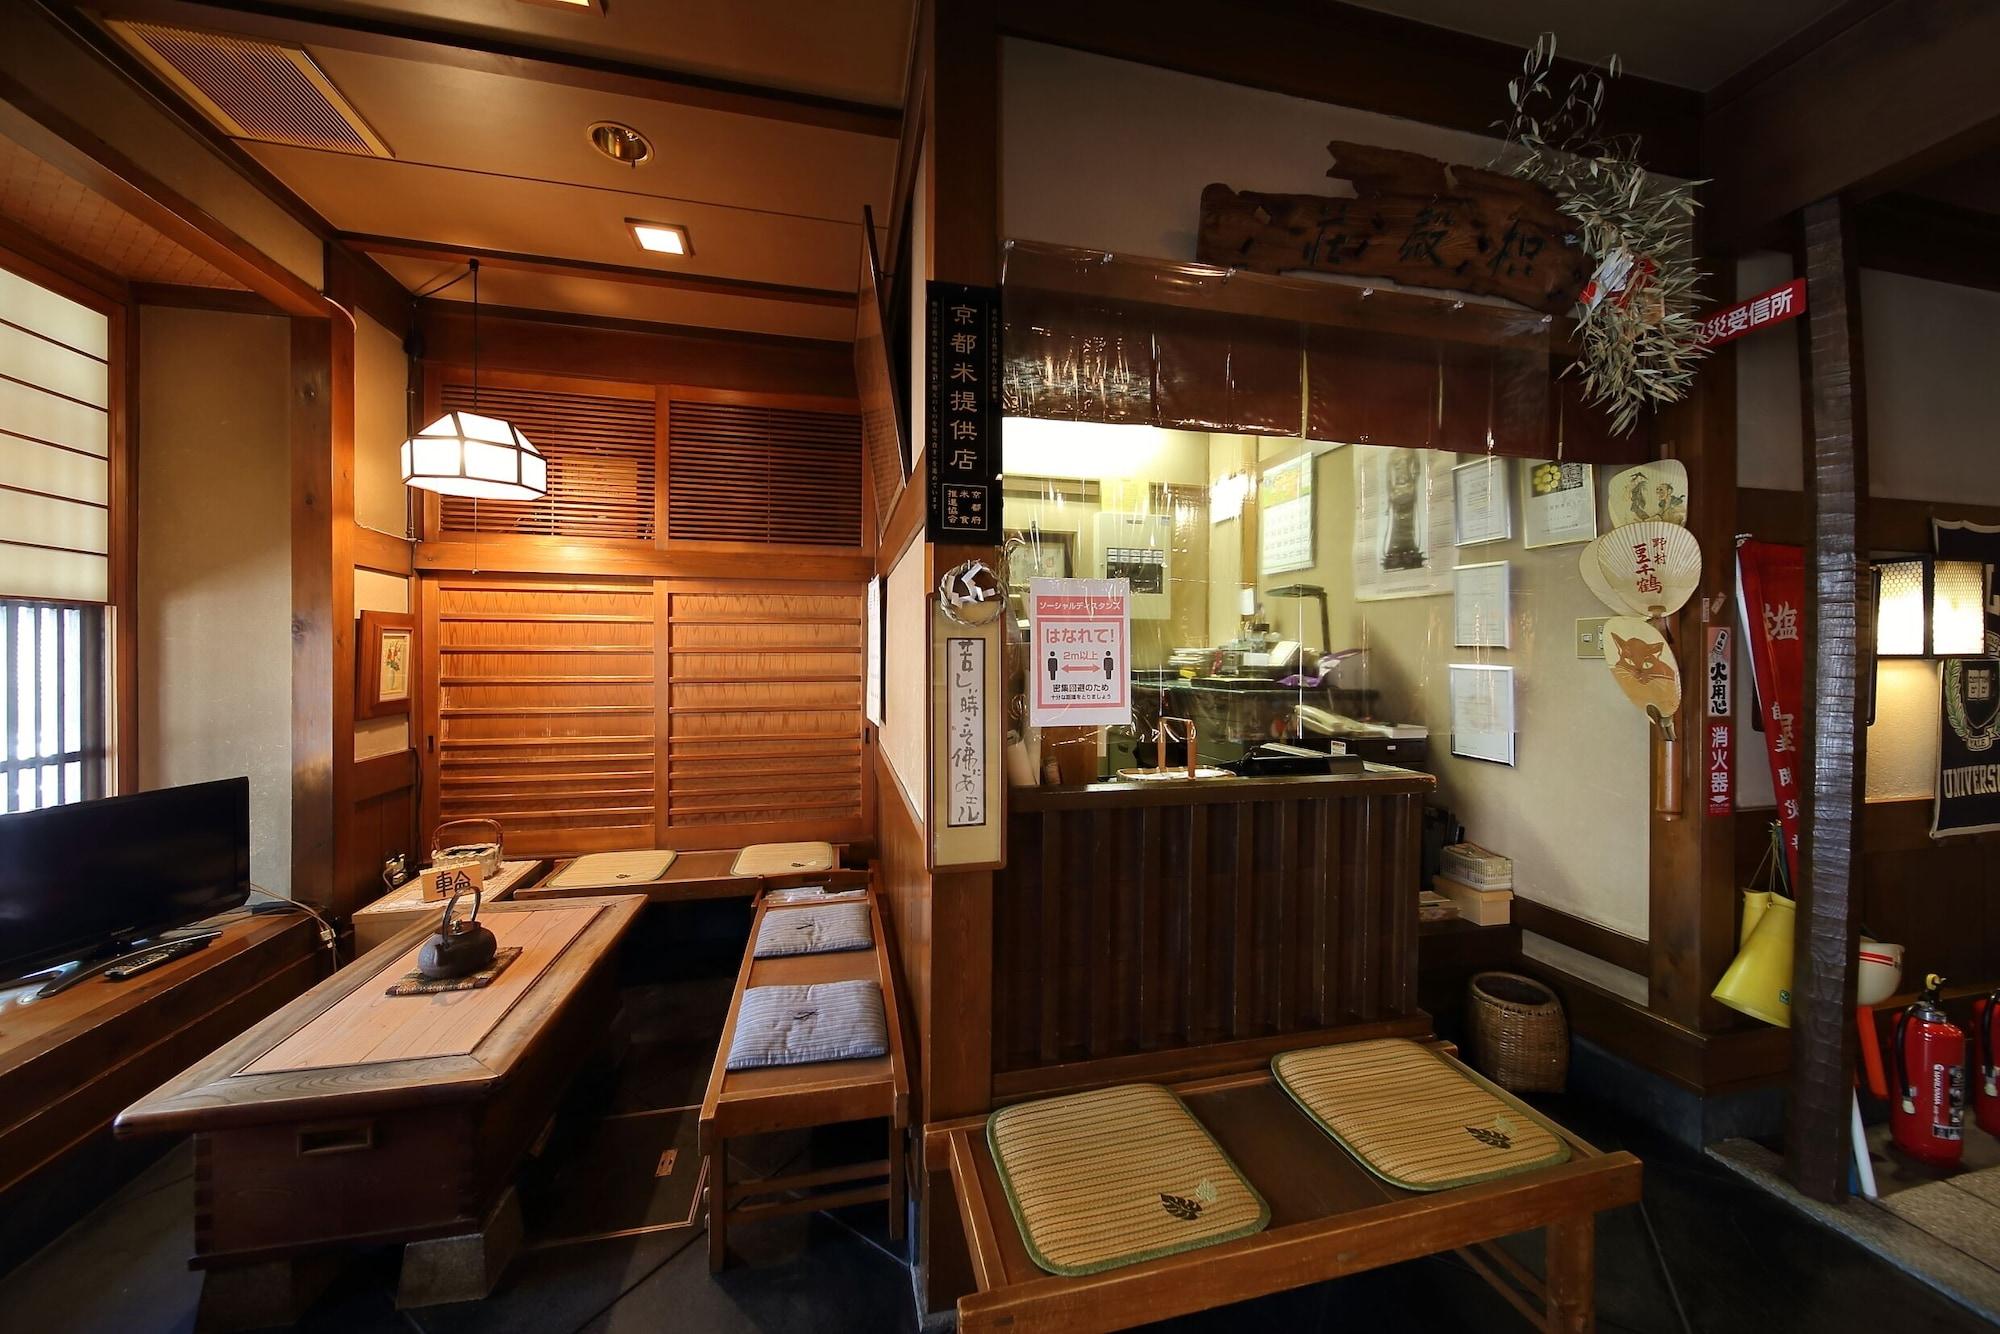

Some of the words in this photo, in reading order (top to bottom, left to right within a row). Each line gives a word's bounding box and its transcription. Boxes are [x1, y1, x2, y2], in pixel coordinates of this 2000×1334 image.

[950, 304, 978, 470] 京都米提供店
[1046, 627, 1114, 644] はなれて!
[1063, 650, 1099, 661] 2m以上
[1710, 662, 1727, 715] 火の用心
[1711, 726, 1729, 792] 消火器
